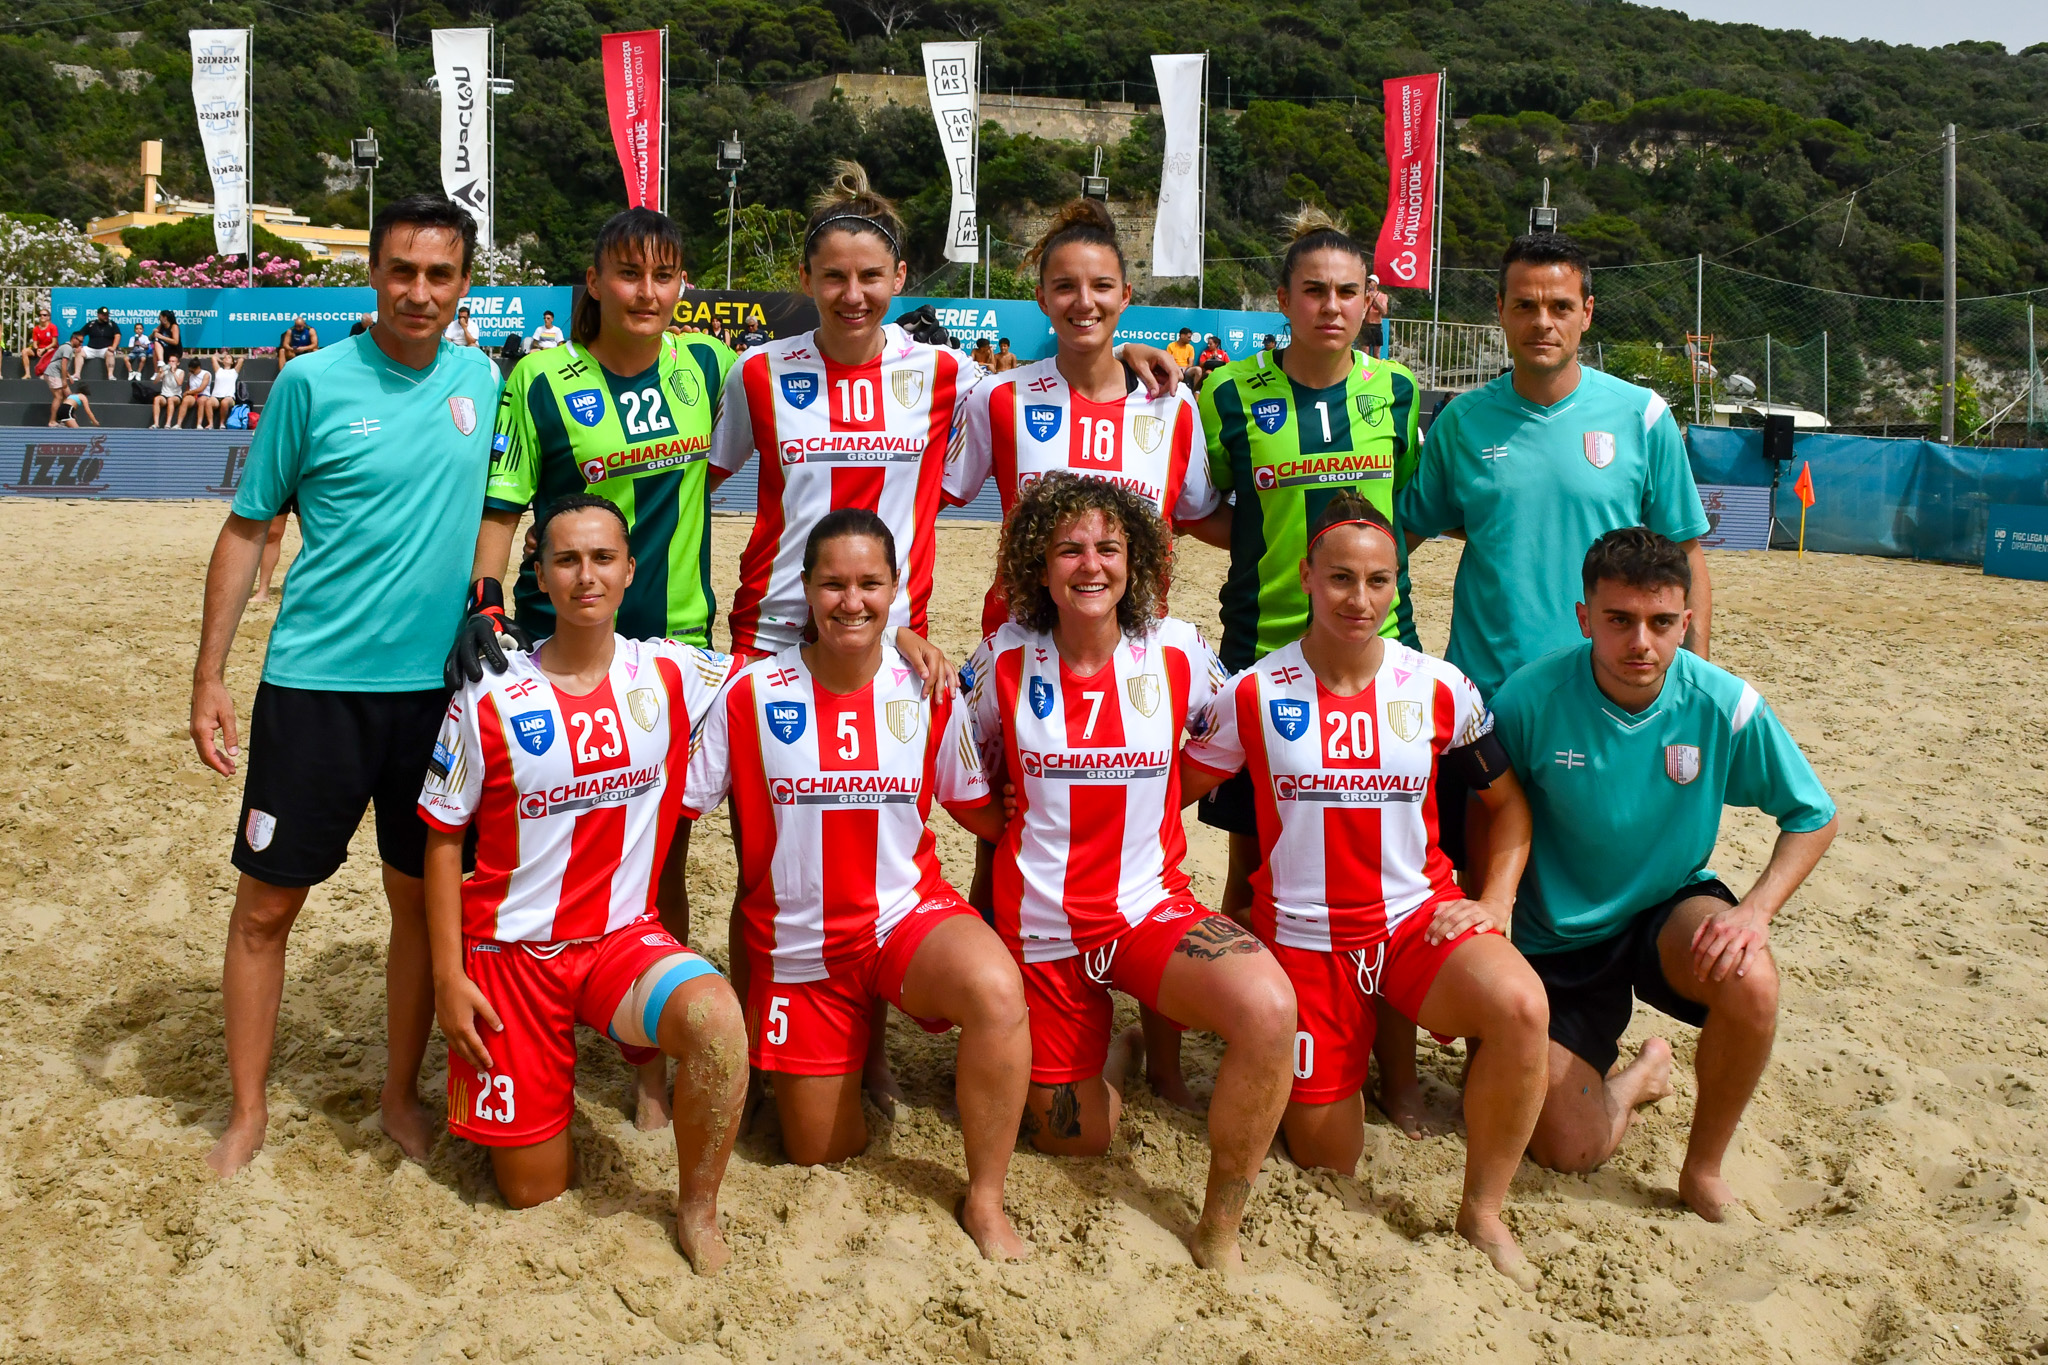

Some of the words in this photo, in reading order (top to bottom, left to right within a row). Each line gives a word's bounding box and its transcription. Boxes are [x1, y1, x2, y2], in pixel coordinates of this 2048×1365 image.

[506, 297, 523, 314] A
[672, 300, 767, 326] GAETA
[980, 310, 998, 328] A
[788, 380, 811, 390] LND
[572, 396, 596, 409] LND
[836, 378, 874, 422] 10
[620, 387, 672, 436] 22
[1032, 411, 1054, 422] LND
[1258, 404, 1280, 415] LND
[1314, 401, 1332, 443] 1
[806, 436, 926, 452] CHIARAVALLI
[1078, 416, 1115, 462] 18
[606, 432, 712, 469] CHIARAVALL
[848, 452, 894, 461] GROUP
[648, 454, 692, 470] GROUP
[1277, 454, 1392, 478] CHIARAVALLI
[1318, 472, 1364, 482] GROUP
[773, 708, 798, 720] LND
[1082, 691, 1105, 740] 7
[1277, 706, 1302, 718] LND
[519, 719, 546, 732] LND
[570, 708, 623, 764] 23
[836, 712, 860, 760] 5
[1326, 710, 1374, 760] 20
[1042, 749, 1170, 770] CHIARAVALLI
[549, 760, 664, 803] CHIARAVALLI
[1086, 770, 1136, 779] GROUP
[1298, 774, 1426, 792] CHIARAVALLI
[796, 776, 921, 794] CHIARAVALLI
[592, 788, 636, 805] GROUP
[838, 794, 887, 804] GROUP
[1340, 792, 1389, 802] GROUP
[766, 996, 790, 1045] 5
[1294, 1031, 1314, 1079] 0
[476, 1071, 516, 1124] 23
